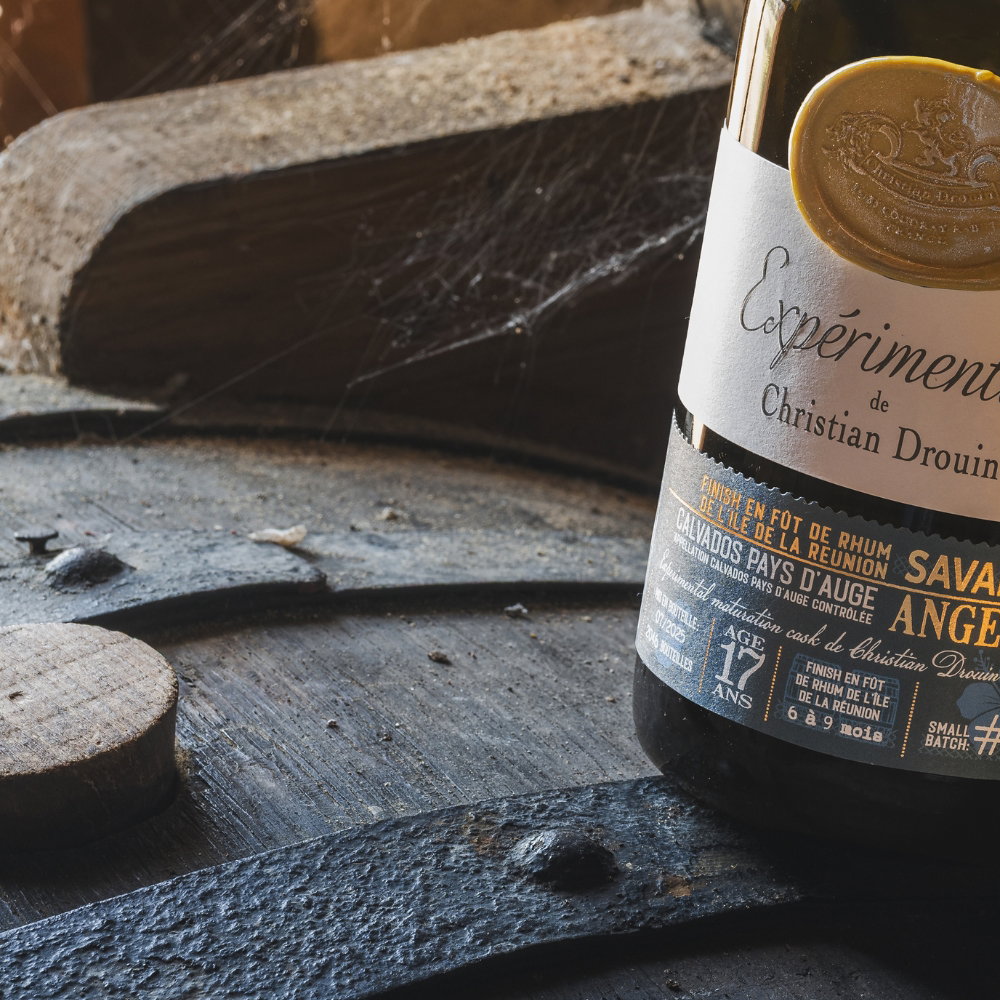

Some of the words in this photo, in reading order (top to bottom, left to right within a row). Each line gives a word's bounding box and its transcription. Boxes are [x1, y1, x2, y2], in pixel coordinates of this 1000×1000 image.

[869, 390, 889, 412] de
[761, 382, 880, 454] Christian
[892, 426, 998, 480] Drouin
[700, 474, 742, 510] FINISH
[745, 498, 765, 520] EN
[809, 522, 832, 544] DE
[838, 531, 892, 561] RHUM
[700, 495, 714, 517] DE
[754, 522, 775, 545] DE
[779, 532, 800, 554] LA
[676, 507, 742, 564] CALVADOS
[746, 547, 795, 585] PAYS
[799, 567, 878, 611] D'AUGE
[710, 557, 749, 584] CALVADOS
[750, 576, 773, 597] PAYS
[775, 586, 810, 607] D'AUGE
[710, 597, 783, 634] maturation
[785, 624, 827, 647] cask
[824, 631, 847, 653] de
[849, 637, 928, 672] Christian
[715, 641, 766, 691] 17
[806, 661, 842, 682] FINISH
[844, 672, 860, 686] EN
[712, 683, 753, 709] ANS
[795, 673, 809, 688] DE
[812, 678, 844, 697] RHUM
[846, 687, 861, 702] DE
[799, 690, 813, 704] DE
[815, 695, 829, 709] LA
[832, 699, 881, 722] RÉUNION
[787, 706, 798, 720] 6
[805, 709, 817, 727] à
[823, 716, 834, 730] 9
[840, 722, 883, 743] mois
[924, 735, 970, 751] BATCH:
[928, 720, 970, 738] SMALL
